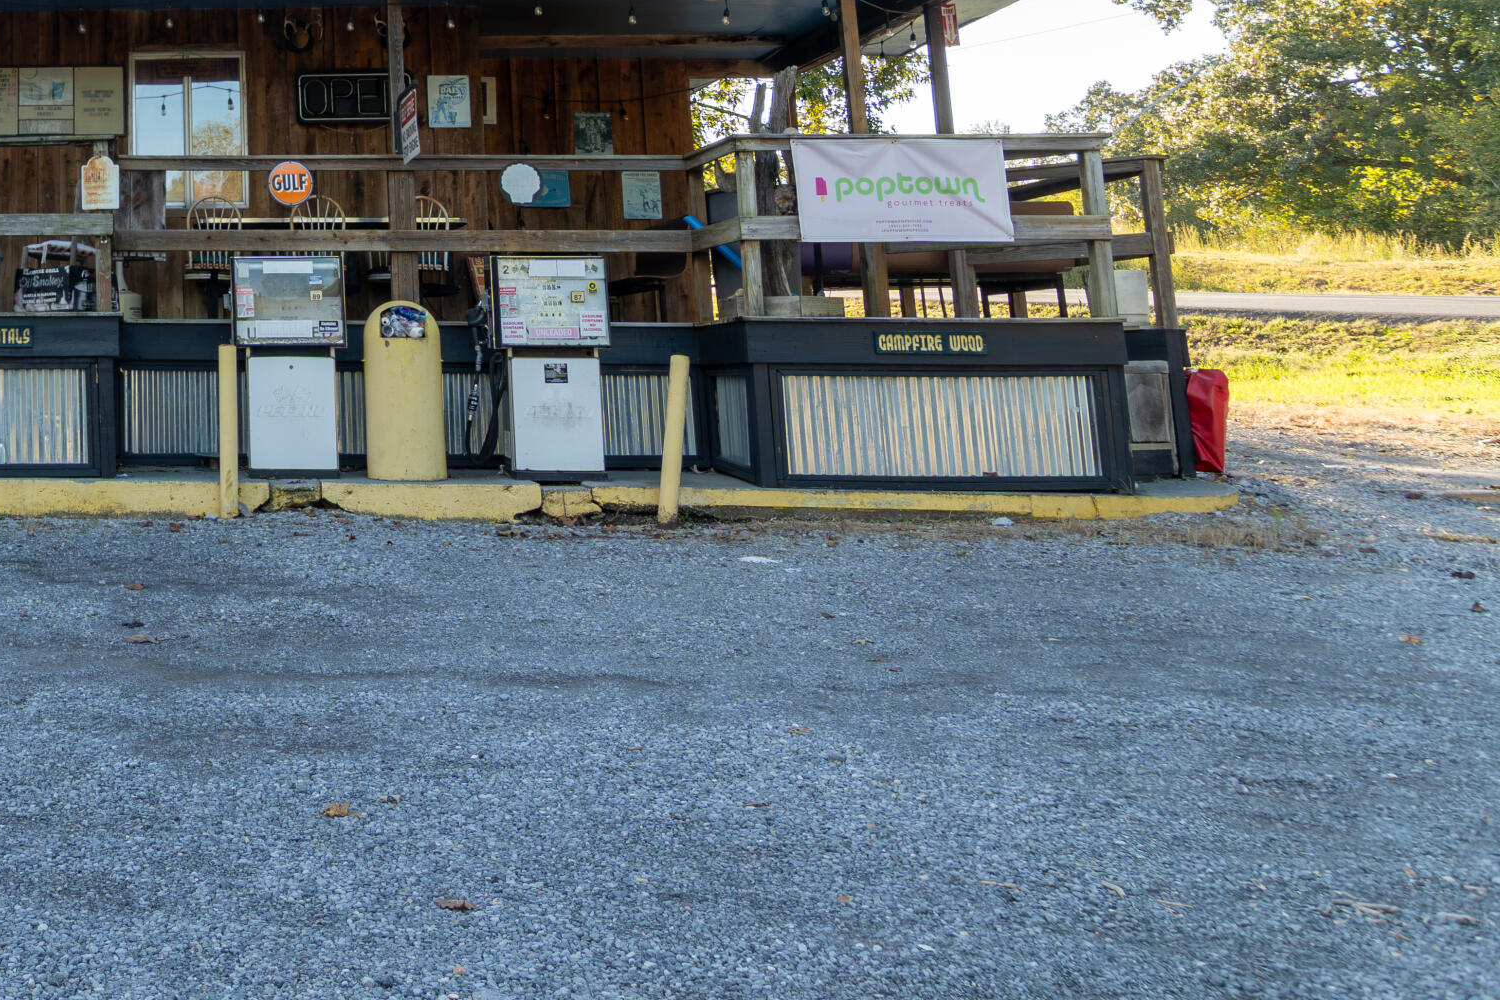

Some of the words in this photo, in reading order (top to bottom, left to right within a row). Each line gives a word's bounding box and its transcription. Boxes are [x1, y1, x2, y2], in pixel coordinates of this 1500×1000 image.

[272, 173, 309, 192] GULF
[835, 172, 987, 203] poptown
[887, 199, 935, 209] gourmet
[939, 198, 974, 207] treats
[502, 265, 509, 275] 2
[878, 334, 943, 352] CAMPFIRE
[948, 334, 984, 352] WOOD
